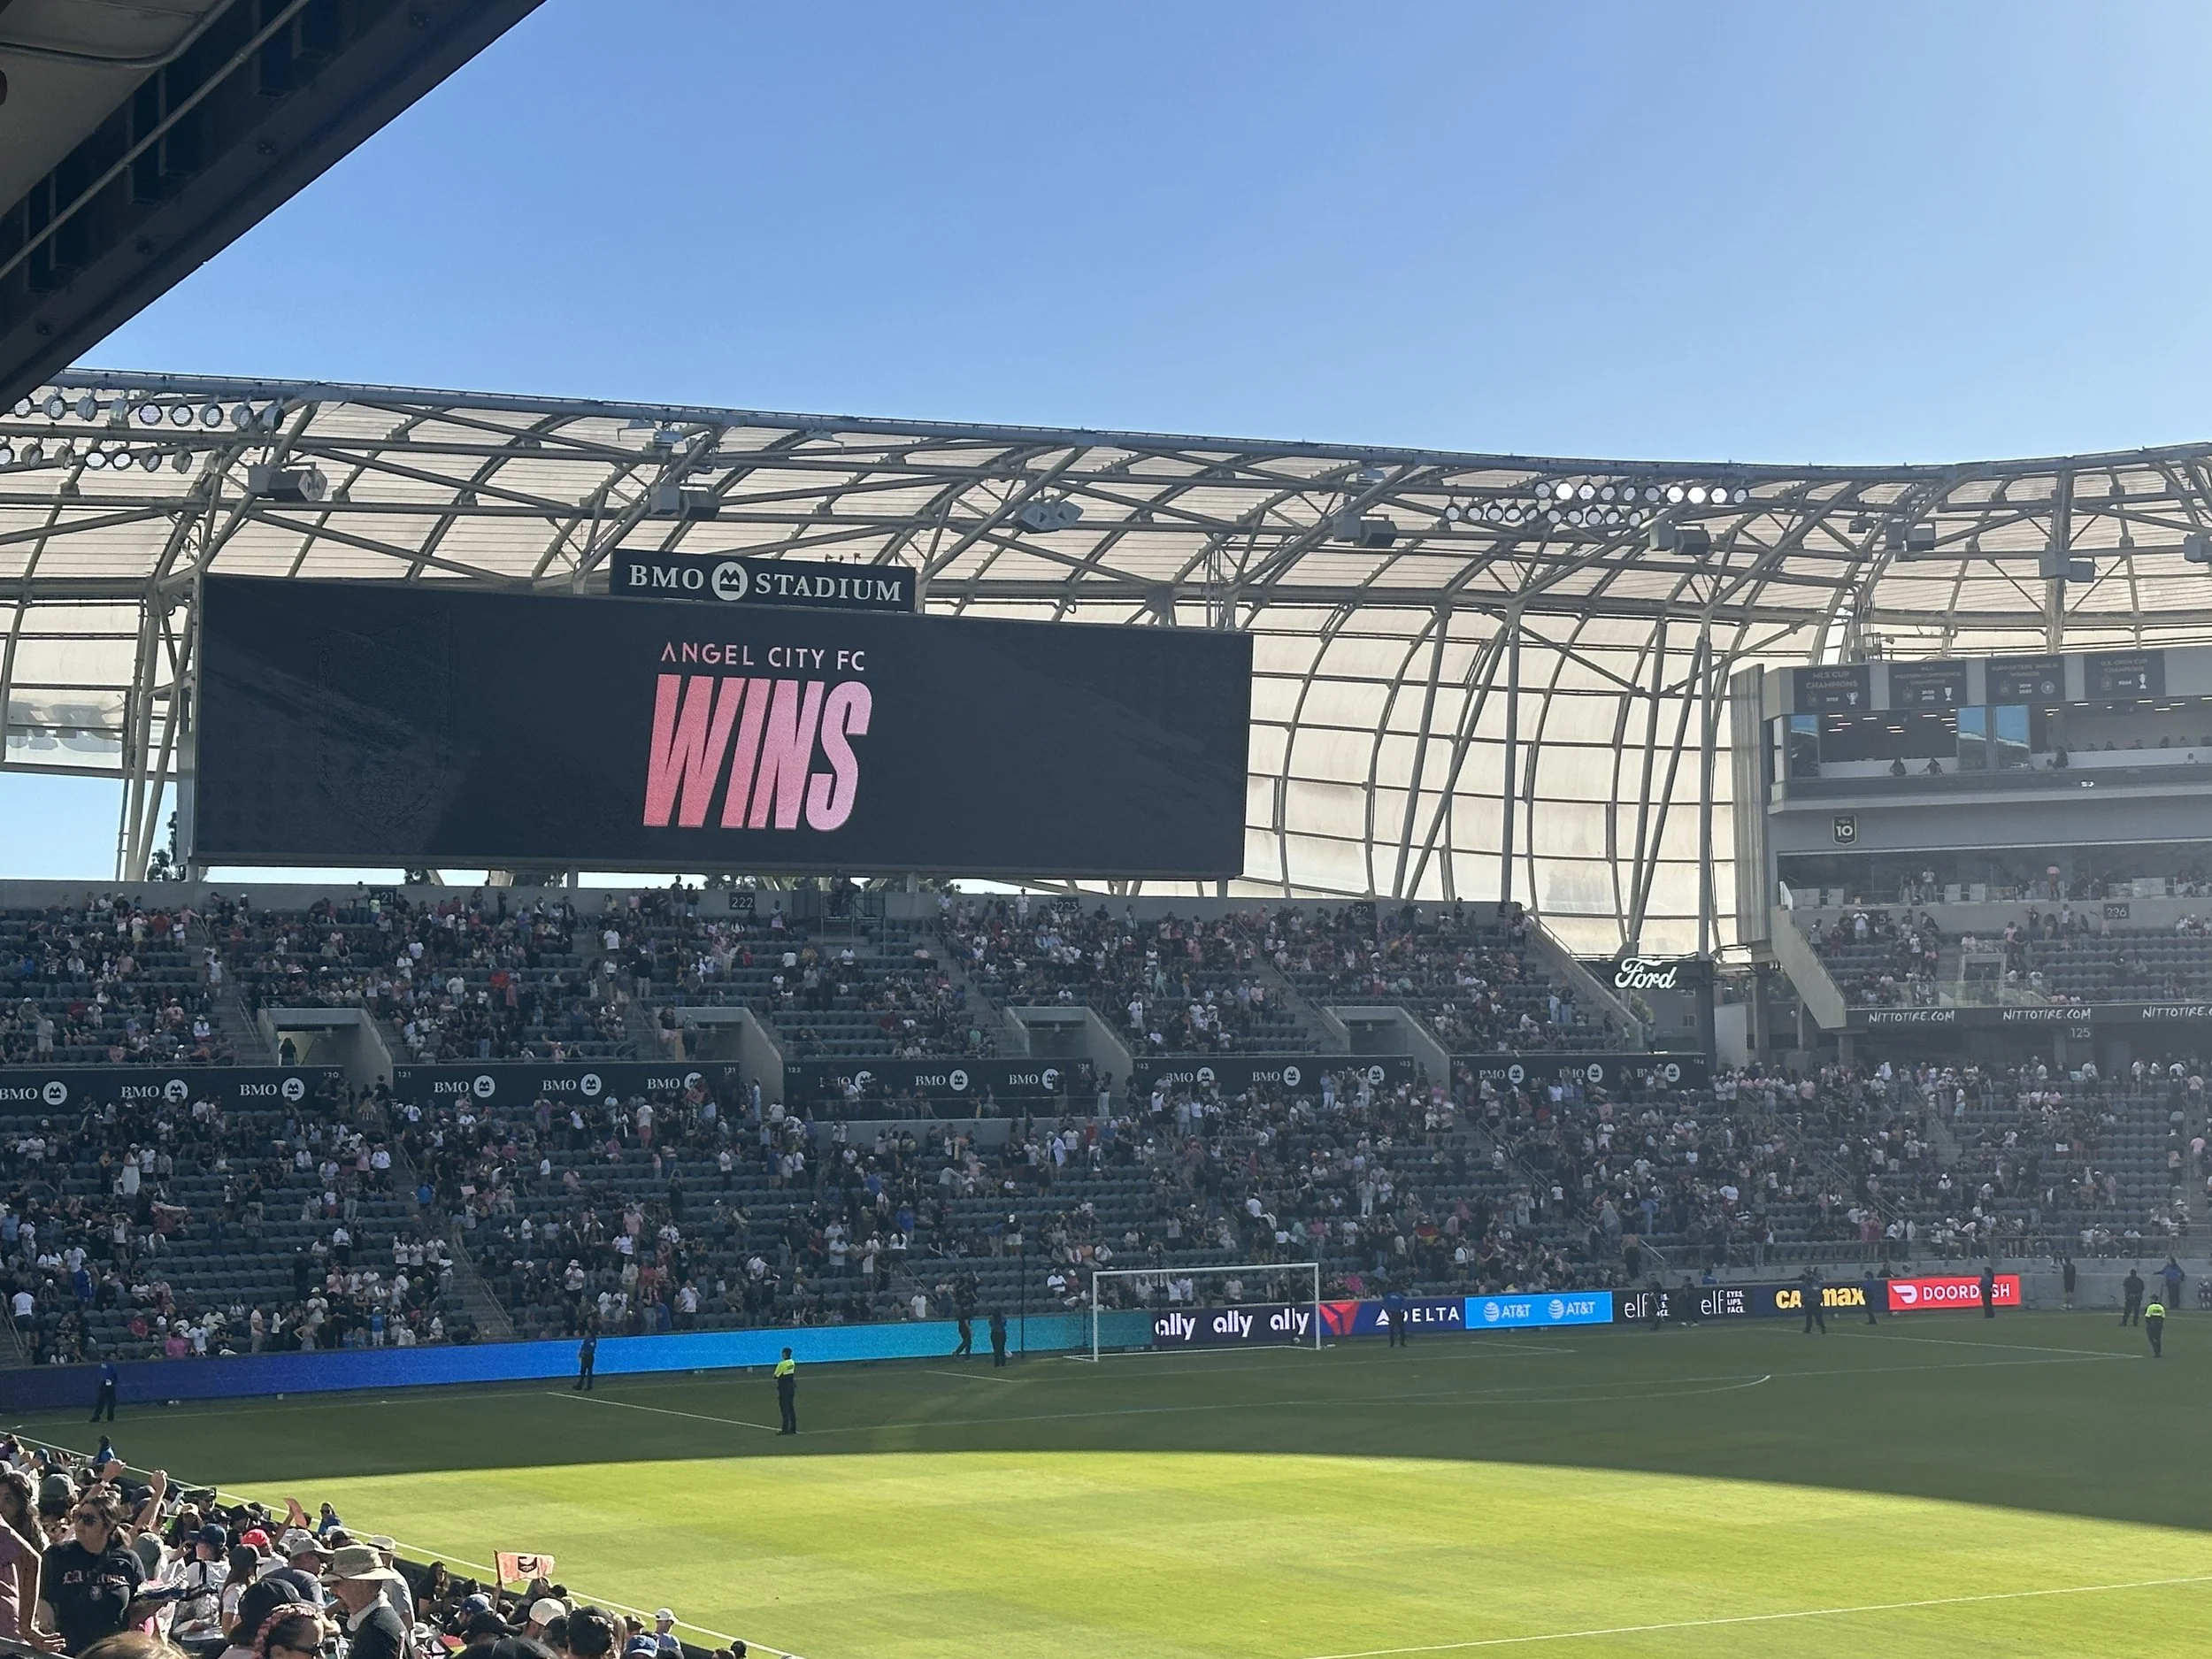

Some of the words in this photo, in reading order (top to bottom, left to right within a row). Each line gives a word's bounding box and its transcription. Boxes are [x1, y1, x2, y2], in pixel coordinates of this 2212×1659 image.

[629, 565, 704, 589] BMO
[755, 573, 902, 601] STADIUM
[661, 641, 754, 666] ANGEL
[768, 646, 826, 670] CITY
[836, 650, 865, 672] FC
[1806, 680, 1858, 689] CHAMPIONS
[643, 673, 872, 831] WINS
[1836, 826, 1853, 837] 10
[732, 896, 753, 908] 222
[1614, 957, 1678, 989] Ford
[1869, 1010, 1955, 1024] NITTOTIRE.COM
[2003, 1008, 2092, 1020] NITTOTIRE.COM
[2070, 1027, 2092, 1038] 125
[915, 1075, 946, 1087] BMO
[1009, 1073, 1039, 1086] BMO
[1252, 1071, 1280, 1082] BMO
[239, 1084, 278, 1096] BMO
[434, 1080, 470, 1094] BMO
[541, 1079, 577, 1091] BMO
[647, 1078, 680, 1090] BMO
[0, 1087, 38, 1101] BMO
[1775, 1287, 1866, 1309] CAmax
[1922, 1283, 2010, 1301] DOORDSH
[1566, 1301, 1595, 1316] AT&T
[1624, 1293, 1649, 1318] elf
[1701, 1289, 1724, 1315] elf
[1501, 1303, 1532, 1318] AT&T
[1155, 1313, 1196, 1340] ally
[1212, 1310, 1254, 1338] ally
[1270, 1308, 1310, 1335] ally
